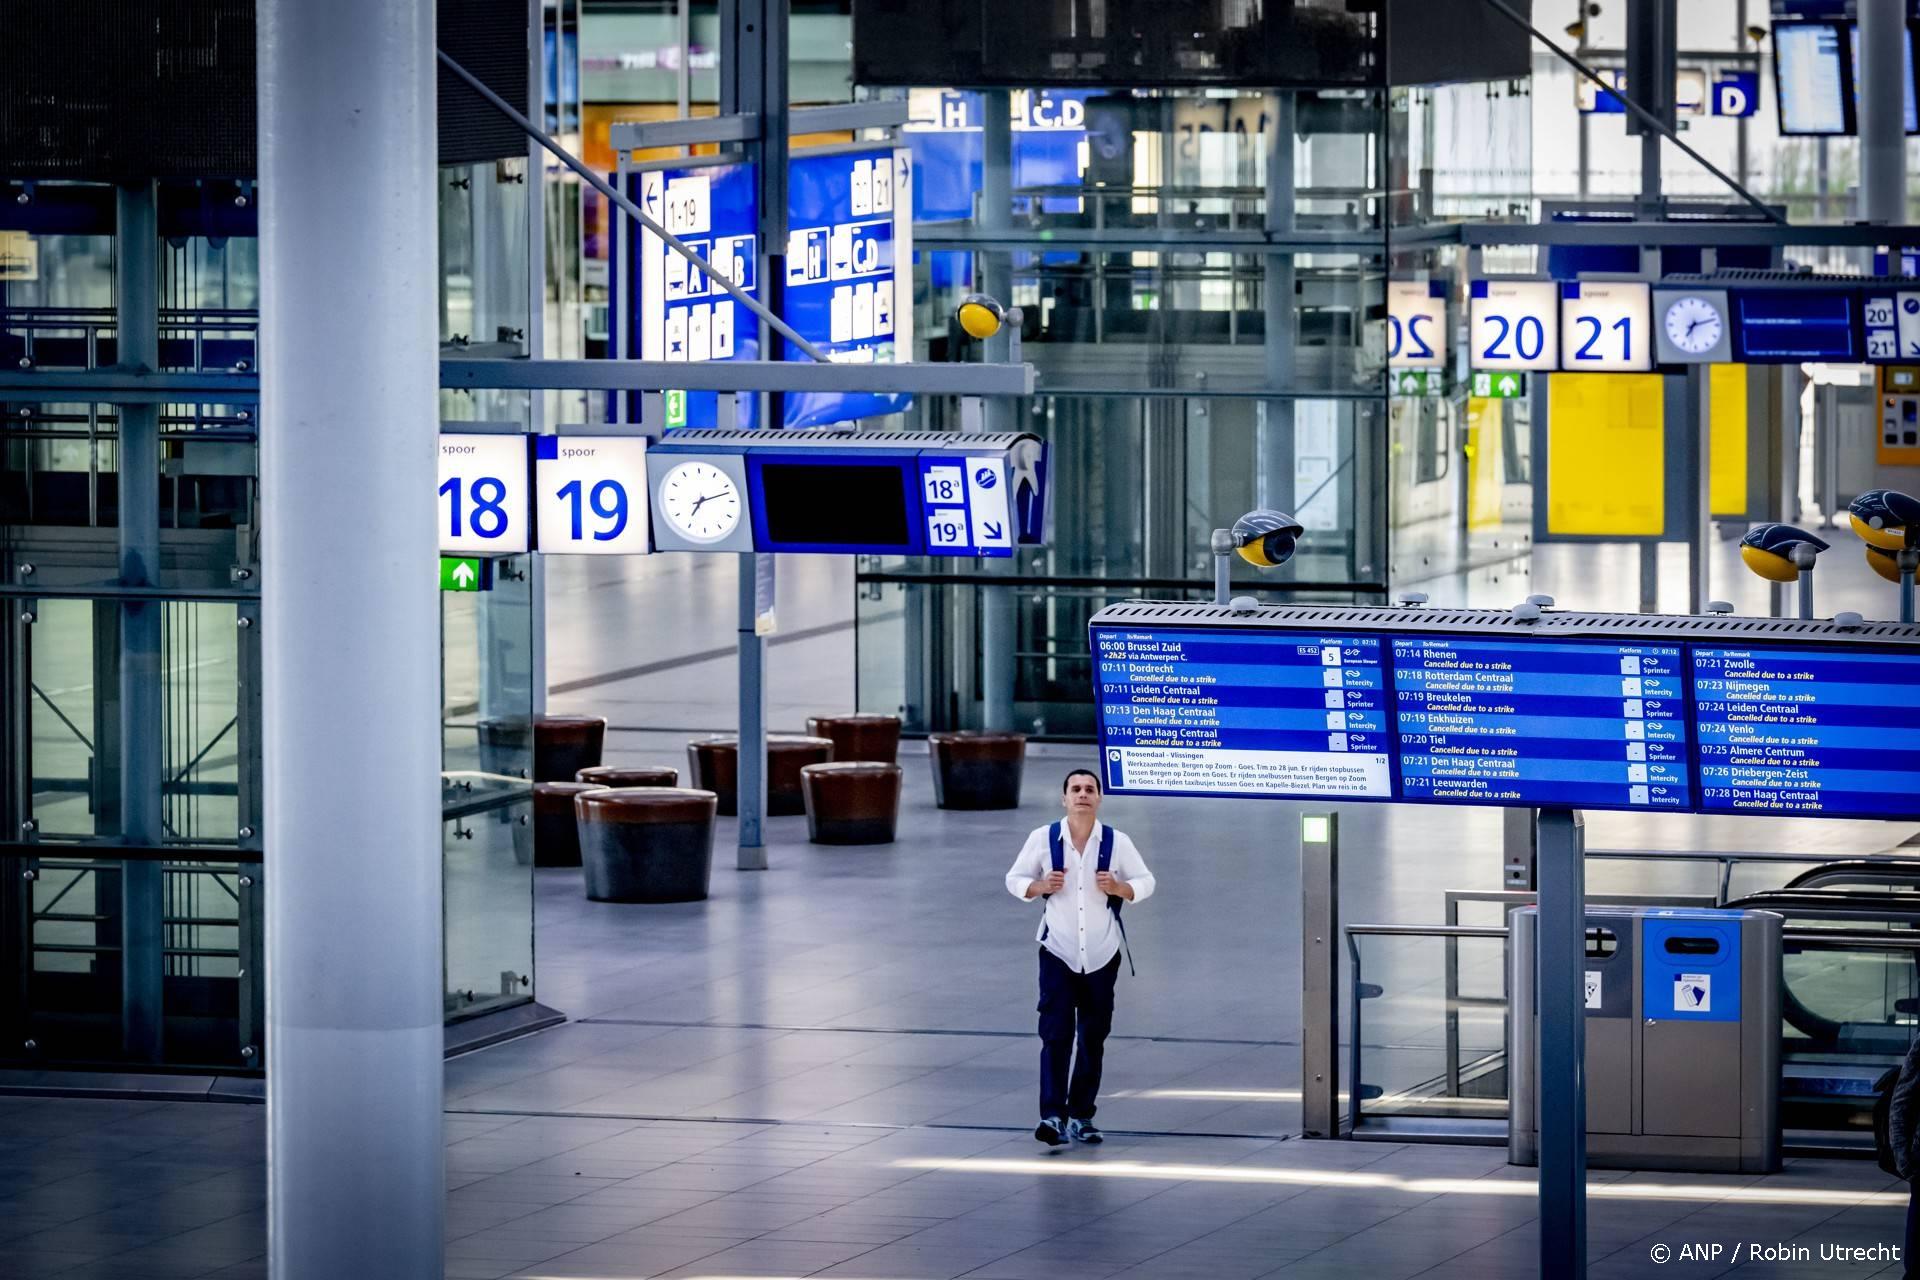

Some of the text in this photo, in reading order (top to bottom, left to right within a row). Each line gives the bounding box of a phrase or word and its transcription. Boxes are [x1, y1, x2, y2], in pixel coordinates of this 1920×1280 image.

[1722, 86, 1746, 116] D
[946, 102, 966, 128] H
[808, 245, 820, 279] H
[734, 256, 745, 288] B
[688, 263, 702, 294] A
[1483, 316, 1544, 360] 20
[1576, 316, 1630, 360] 21
[442, 446, 476, 455] spoor
[562, 448, 596, 458] spoor
[439, 477, 508, 538] 18
[556, 480, 628, 541] 19
[1101, 642, 1181, 652] 06:00 Brussel Zuid
[1141, 653, 1179, 662] Antwerpen
[1396, 649, 1457, 659] 07:14 Rhenen
[1102, 663, 1174, 673] 07:11 Dordrecht
[1696, 659, 1755, 669] 07:21 Zwolle
[1398, 671, 1513, 682] 07:18 Rotterdam Centraal
[1104, 684, 1200, 695] 07:11 Leiden Centraal
[1697, 681, 1770, 693] 07:23 Nijmegen
[1399, 692, 1472, 702] 07:19 Breukelen
[1106, 706, 1215, 717] 07:13 Den Haag Centraal
[1699, 703, 1799, 714] 07:24 Leiden Centraal
[1401, 713, 1473, 724] 07:19 Enkhuizen
[1108, 727, 1217, 739] 07:14 Den Haag Centraal
[1701, 724, 1754, 734] 07:24 Venlo
[1402, 735, 1446, 744] 07:20 Tiel
[1702, 746, 1805, 757] 07:25 Almere Centrum
[1404, 756, 1515, 768] 07:21 Den Haag Centraal
[1704, 767, 1808, 780] 07:26 Driebergen-Zeist
[1406, 778, 1488, 788] 07:21 Leeuwarden
[1705, 789, 1818, 802] 07:28 Den Haag Centraal
